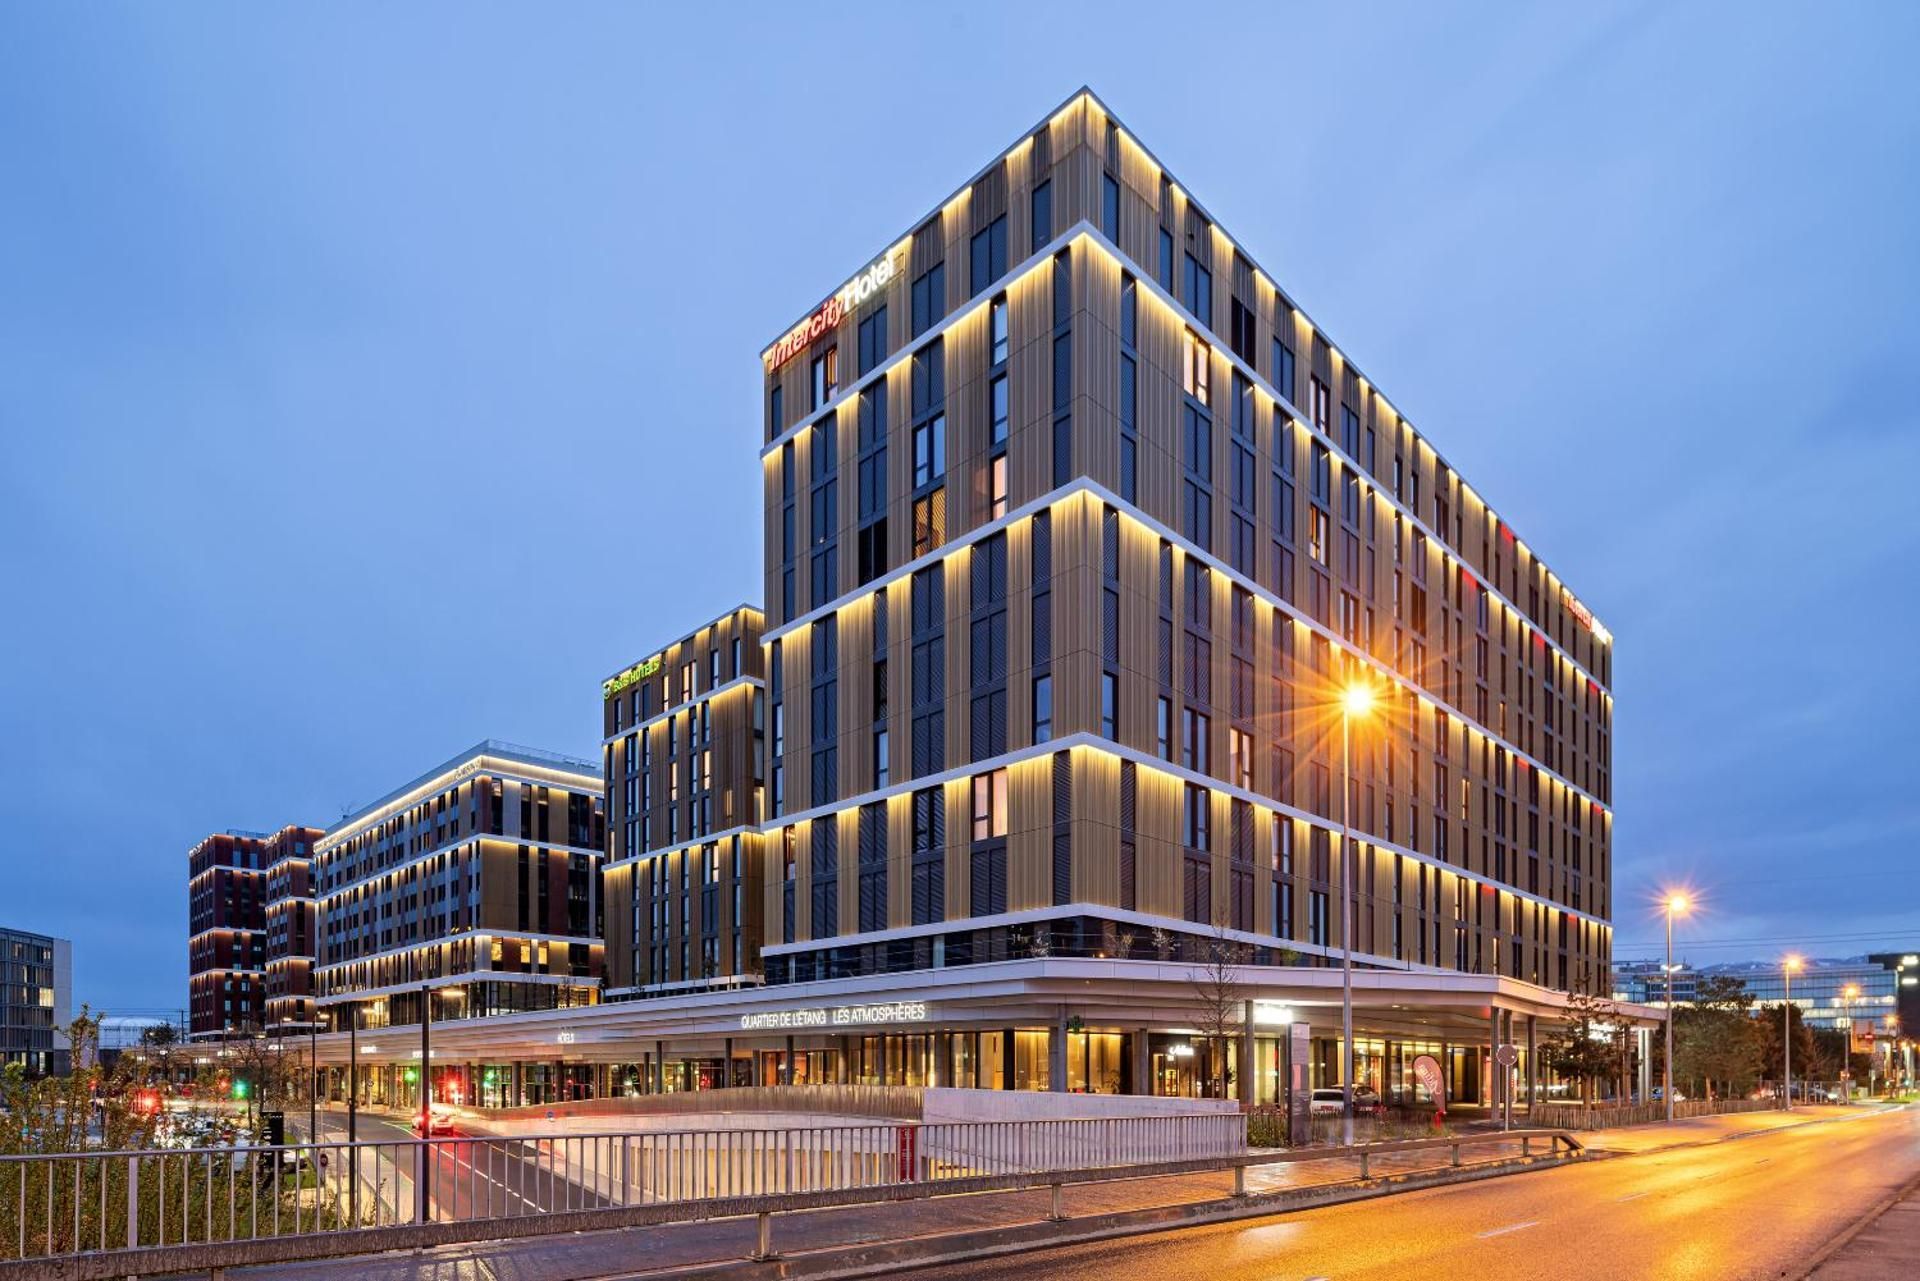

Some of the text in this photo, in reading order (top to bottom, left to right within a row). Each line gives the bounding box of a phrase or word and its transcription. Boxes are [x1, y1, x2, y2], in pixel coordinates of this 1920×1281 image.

[741, 1014, 779, 1029] QUARTIER
[780, 1012, 791, 1026] DE
[832, 1008, 850, 1024] LES
[850, 1001, 925, 1023] ATMOSPHÈRES
